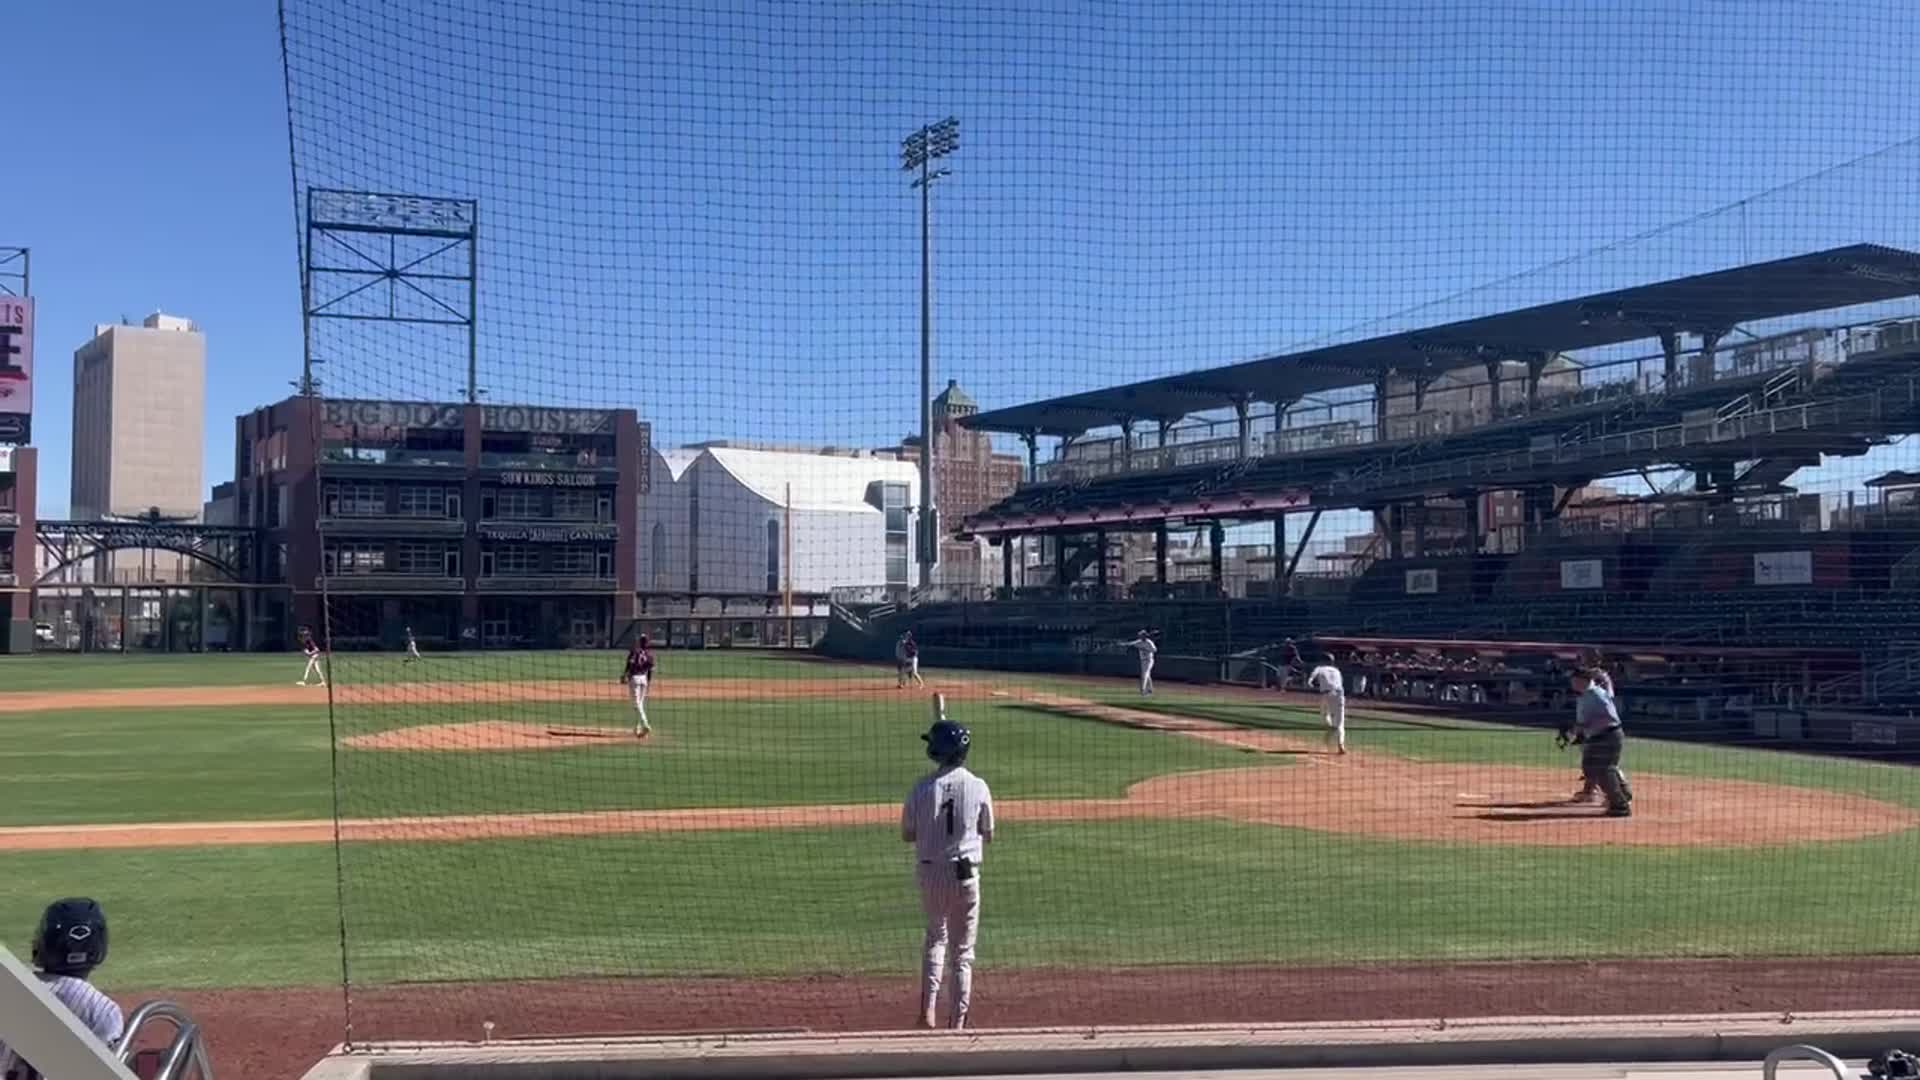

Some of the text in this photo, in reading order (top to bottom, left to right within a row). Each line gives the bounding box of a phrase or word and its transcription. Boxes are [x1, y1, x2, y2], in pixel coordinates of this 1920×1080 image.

[321, 401, 580, 433] BIG DOG HOUSE
[500, 471, 597, 486] SUN KINGS SALOON
[487, 530, 528, 540] TEQUILA
[569, 530, 612, 540] CANTINA
[941, 798, 954, 835] 1
